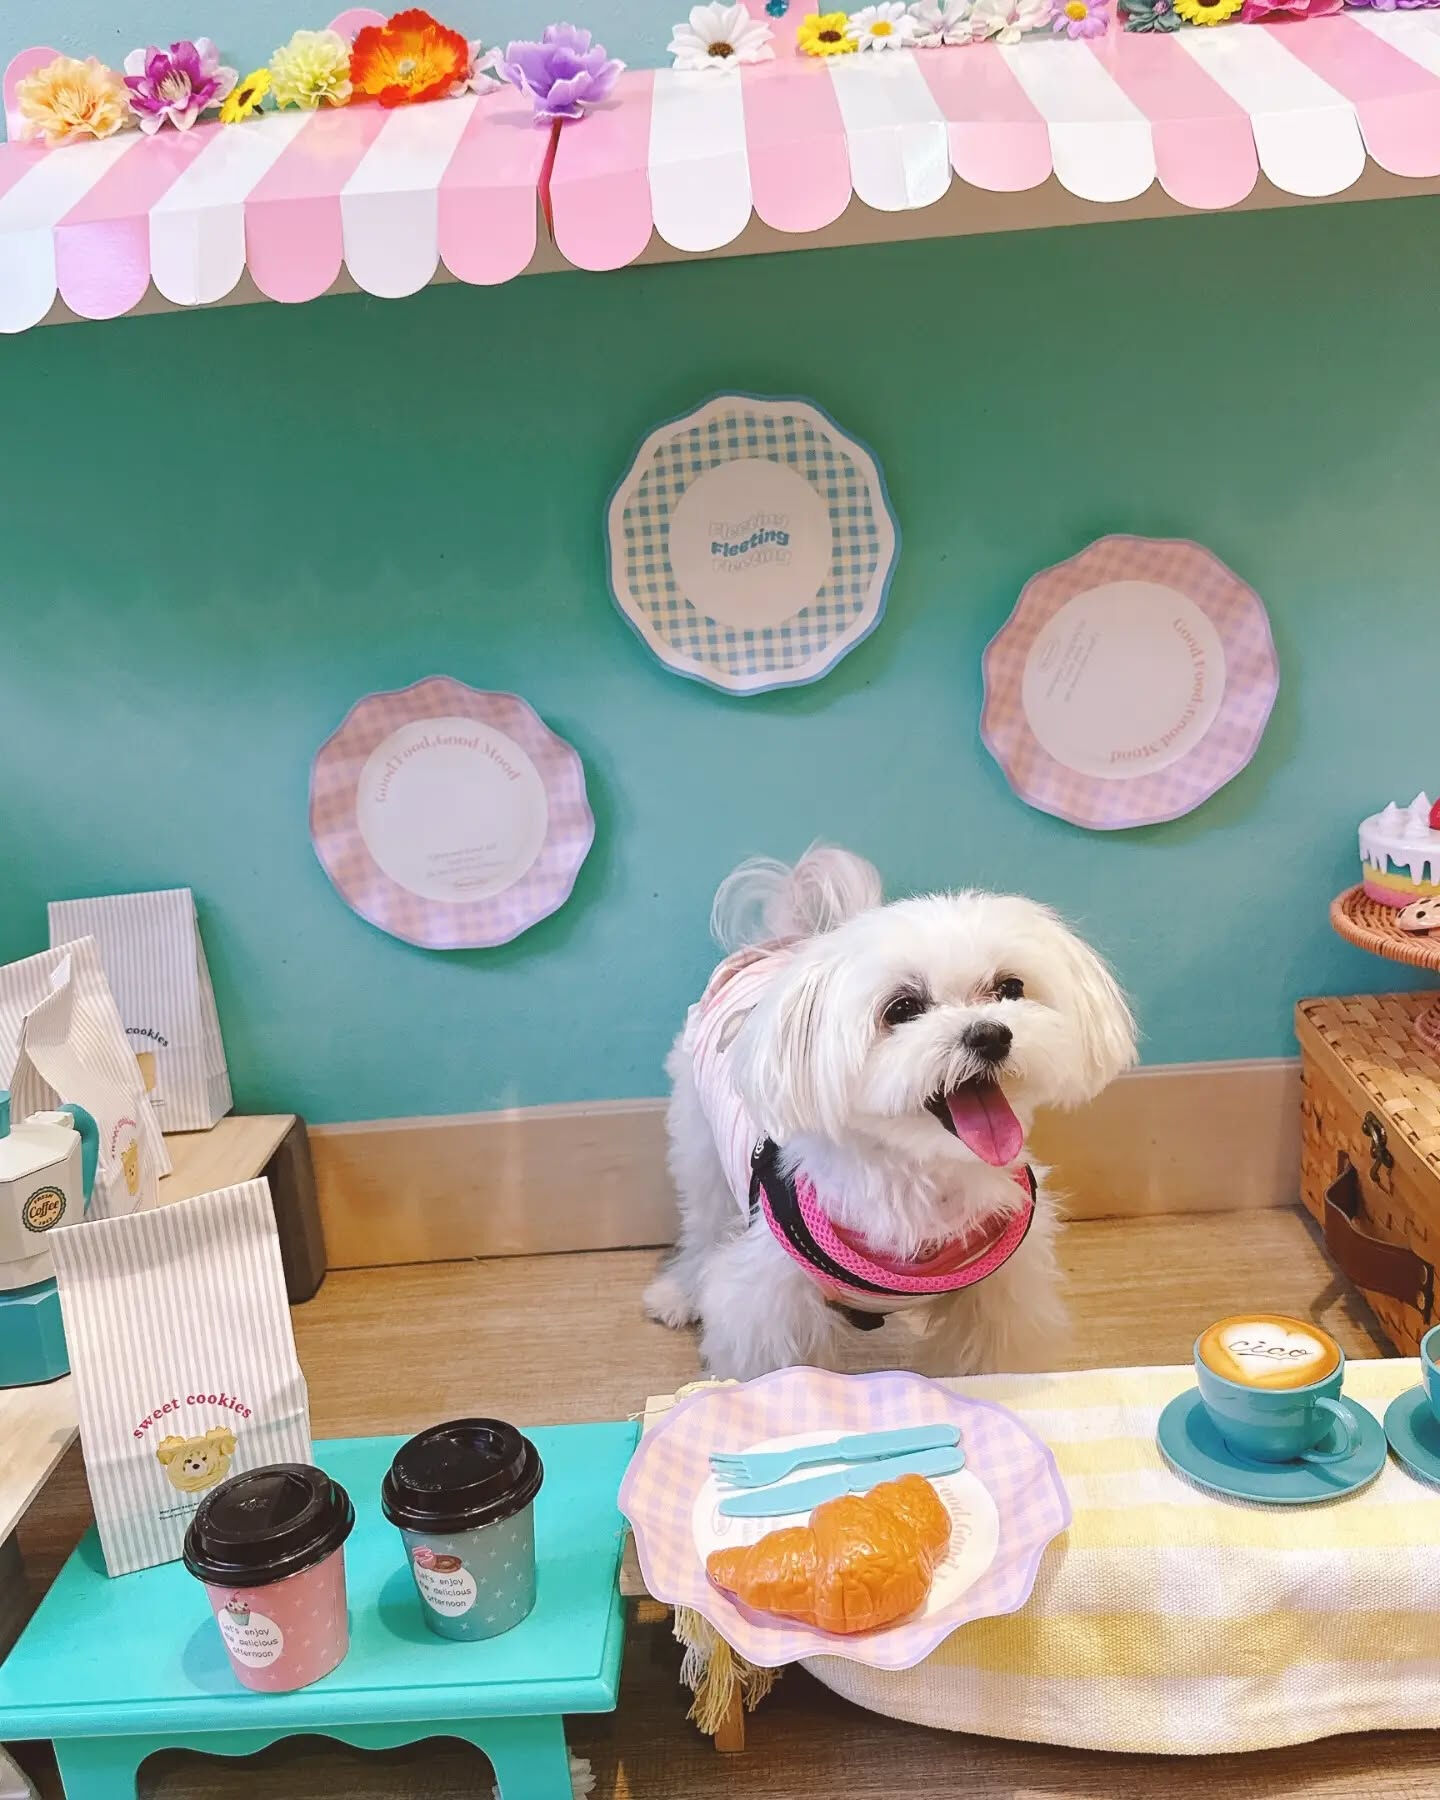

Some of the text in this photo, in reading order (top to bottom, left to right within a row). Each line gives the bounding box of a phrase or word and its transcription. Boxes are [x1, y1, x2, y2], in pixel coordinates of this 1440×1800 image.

[711, 528, 790, 557] Fleeting
[125, 1026, 169, 1048] cookies
[29, 1201, 60, 1218] Coffee
[133, 1392, 253, 1440] sweet cookies
[439, 1578, 464, 1587] enjoy
[433, 1588, 472, 1597] delicious
[244, 1628, 270, 1638] enjoy
[239, 1638, 279, 1647] delicious
